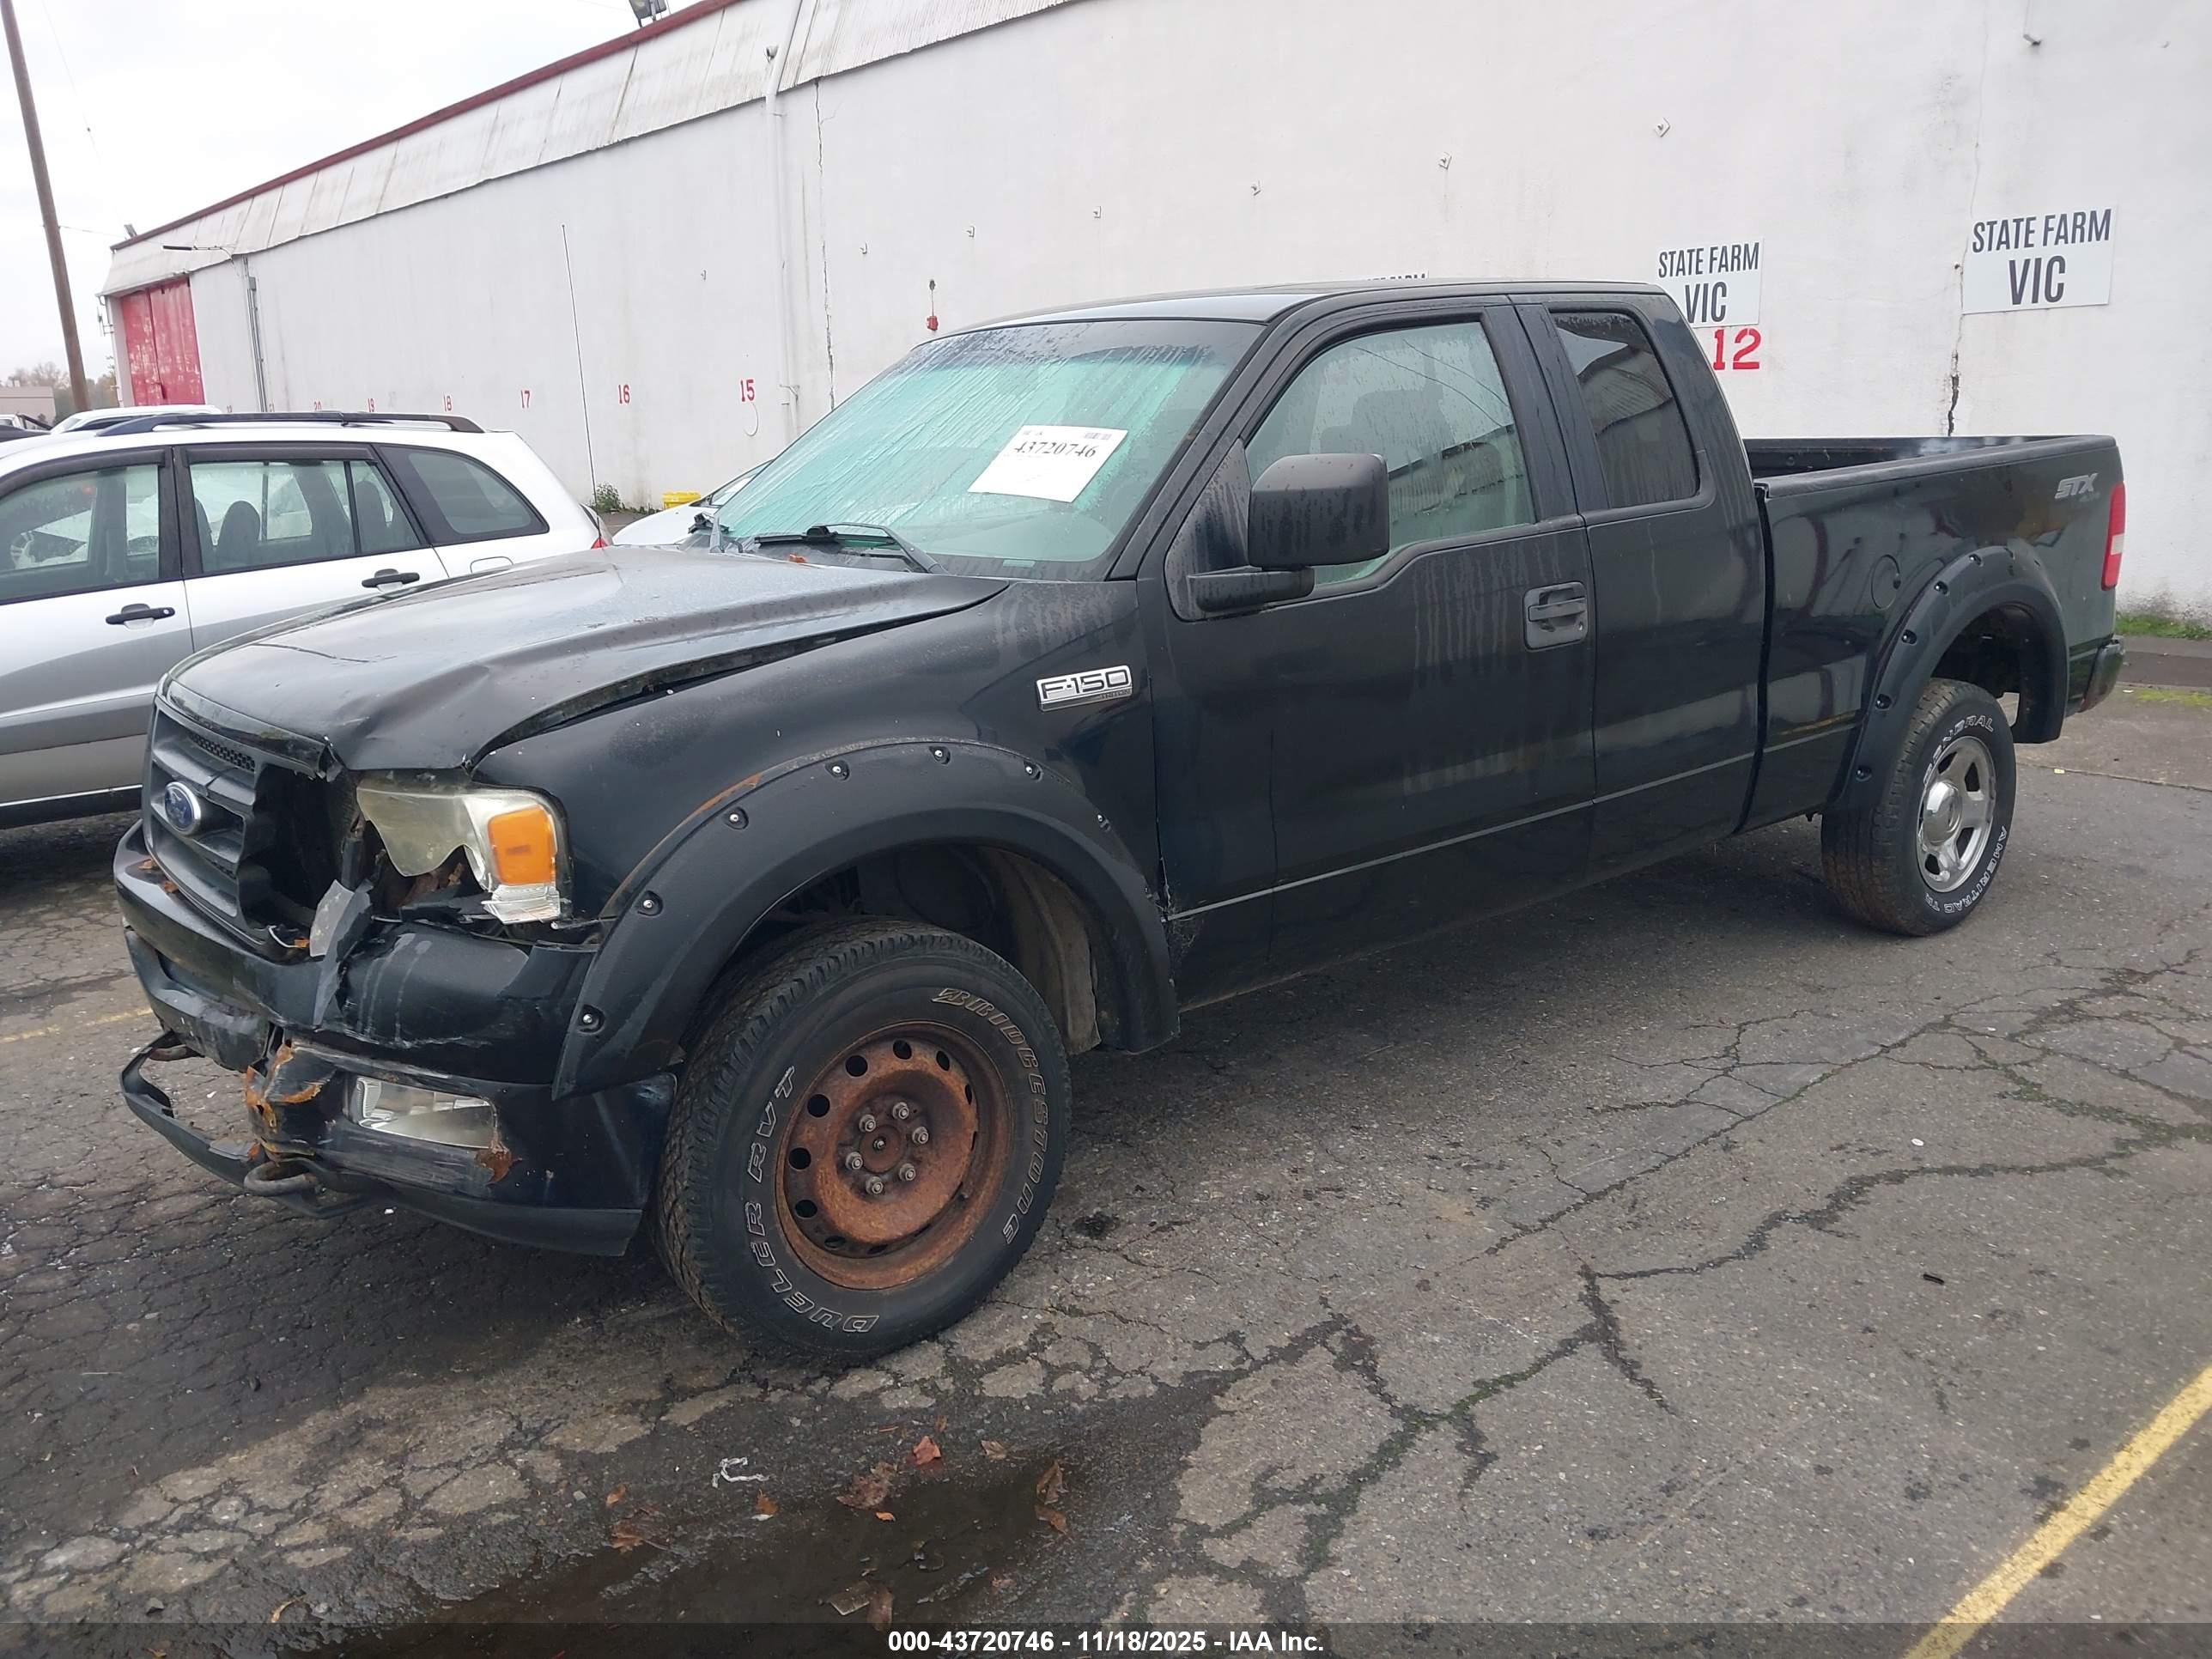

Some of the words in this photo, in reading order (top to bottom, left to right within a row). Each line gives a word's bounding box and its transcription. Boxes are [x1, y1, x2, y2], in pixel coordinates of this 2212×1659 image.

[1972, 216, 2035, 253] STATE
[2042, 209, 2112, 246] FARM
[1657, 246, 1705, 279] STATE
[1709, 241, 1759, 273] FARM
[2008, 256, 2067, 306] VIC
[1685, 282, 1728, 324] VIC
[1713, 328, 1761, 370] 12
[442, 395, 453, 412] 18
[520, 390, 531, 408] 17
[617, 384, 631, 404] 16
[739, 379, 755, 402] 15
[1014, 441, 1099, 458] 43720746
[2055, 472, 2099, 499] STX
[1041, 669, 1129, 699] F-150
[1944, 825, 2007, 914] AMERITRAC
[931, 988, 1049, 1244] BRIDGESTONE
[744, 1201, 880, 1332] DUELER
